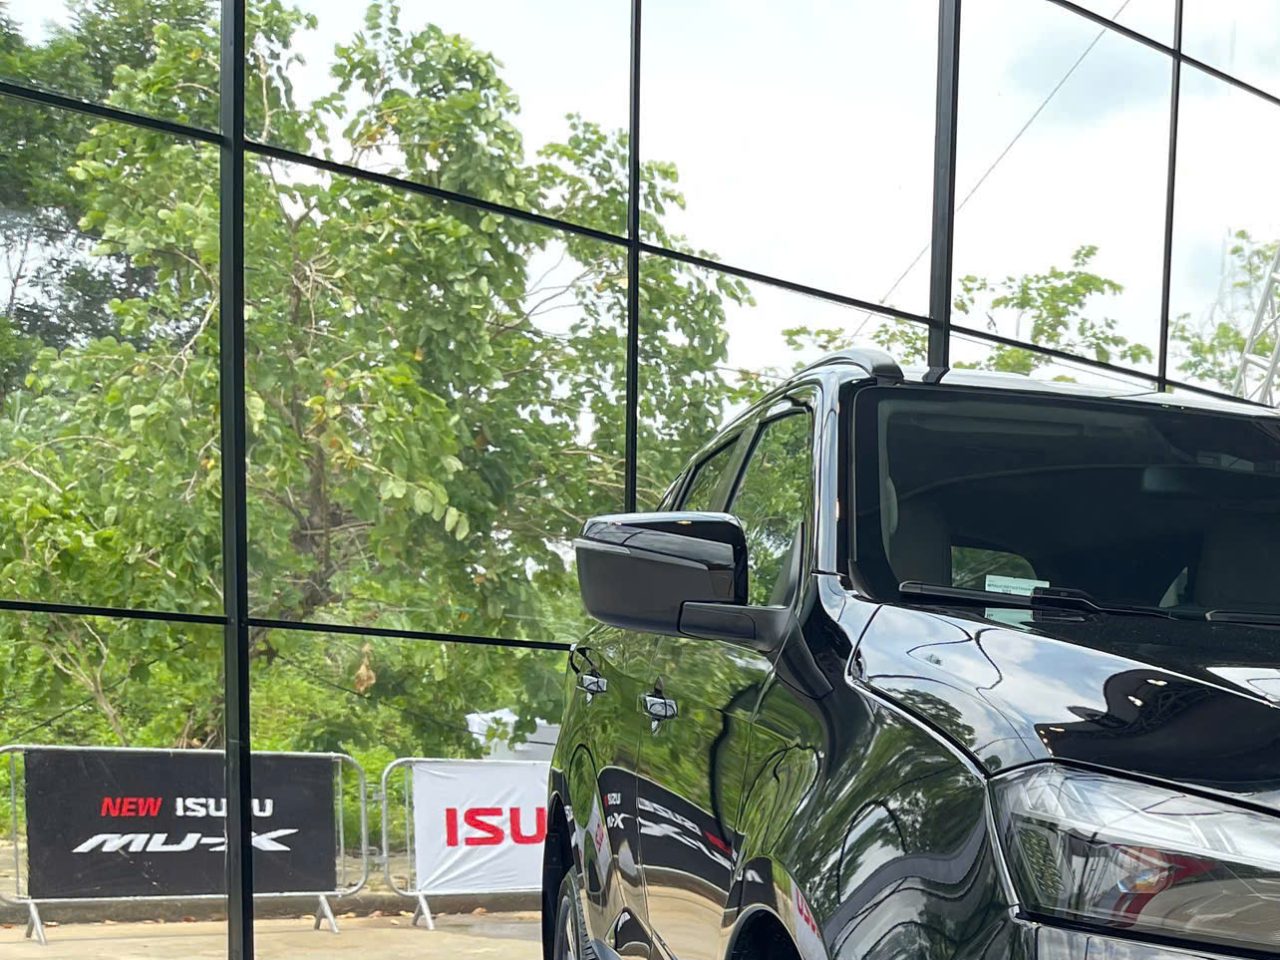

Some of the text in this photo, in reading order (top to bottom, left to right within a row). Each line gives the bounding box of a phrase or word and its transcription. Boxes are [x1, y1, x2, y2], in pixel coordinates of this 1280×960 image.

[101, 797, 274, 817] NEW ISUU
[445, 806, 548, 847] ISU
